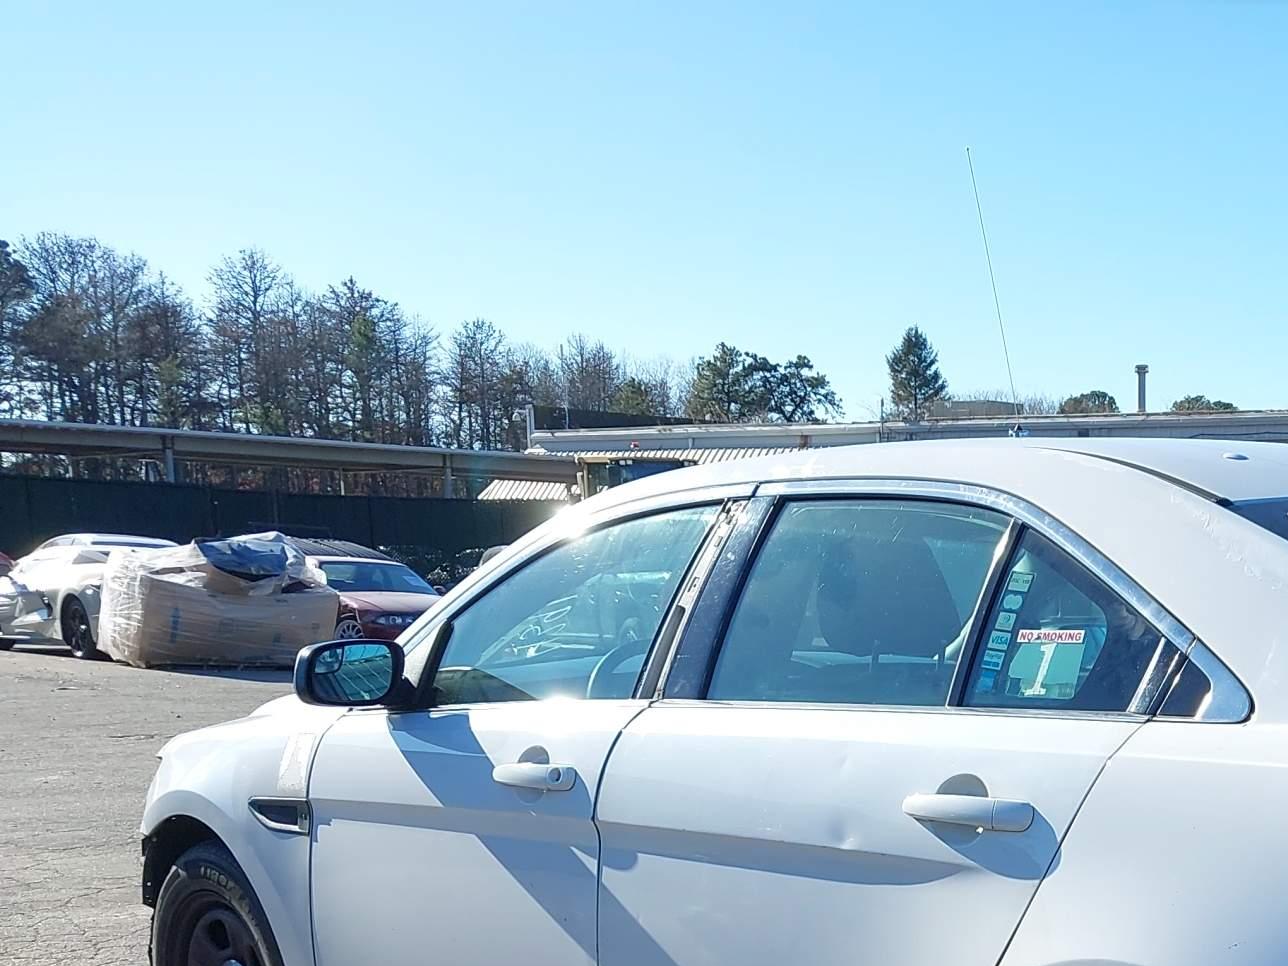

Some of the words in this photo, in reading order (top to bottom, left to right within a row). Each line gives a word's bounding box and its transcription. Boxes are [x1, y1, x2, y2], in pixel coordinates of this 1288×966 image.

[991, 635, 1009, 646] VISA
[1019, 632, 1034, 641] NO
[1037, 632, 1082, 642] SMOKING
